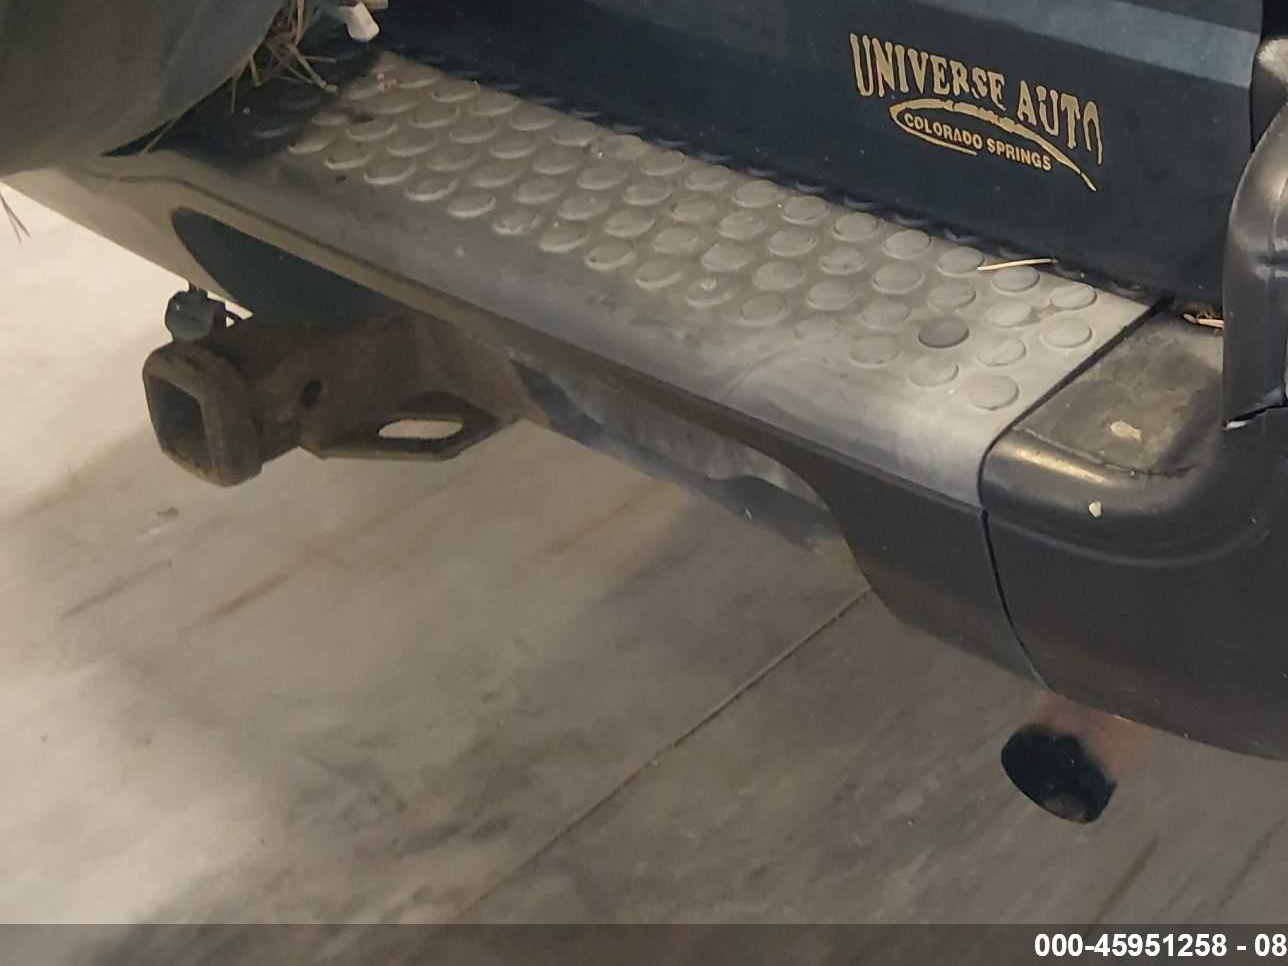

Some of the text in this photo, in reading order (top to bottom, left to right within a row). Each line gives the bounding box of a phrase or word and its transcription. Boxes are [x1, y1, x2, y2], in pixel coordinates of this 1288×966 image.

[849, 32, 1007, 111] UNIVERSE
[903, 112, 1053, 172] COLORADO SPRINGS
